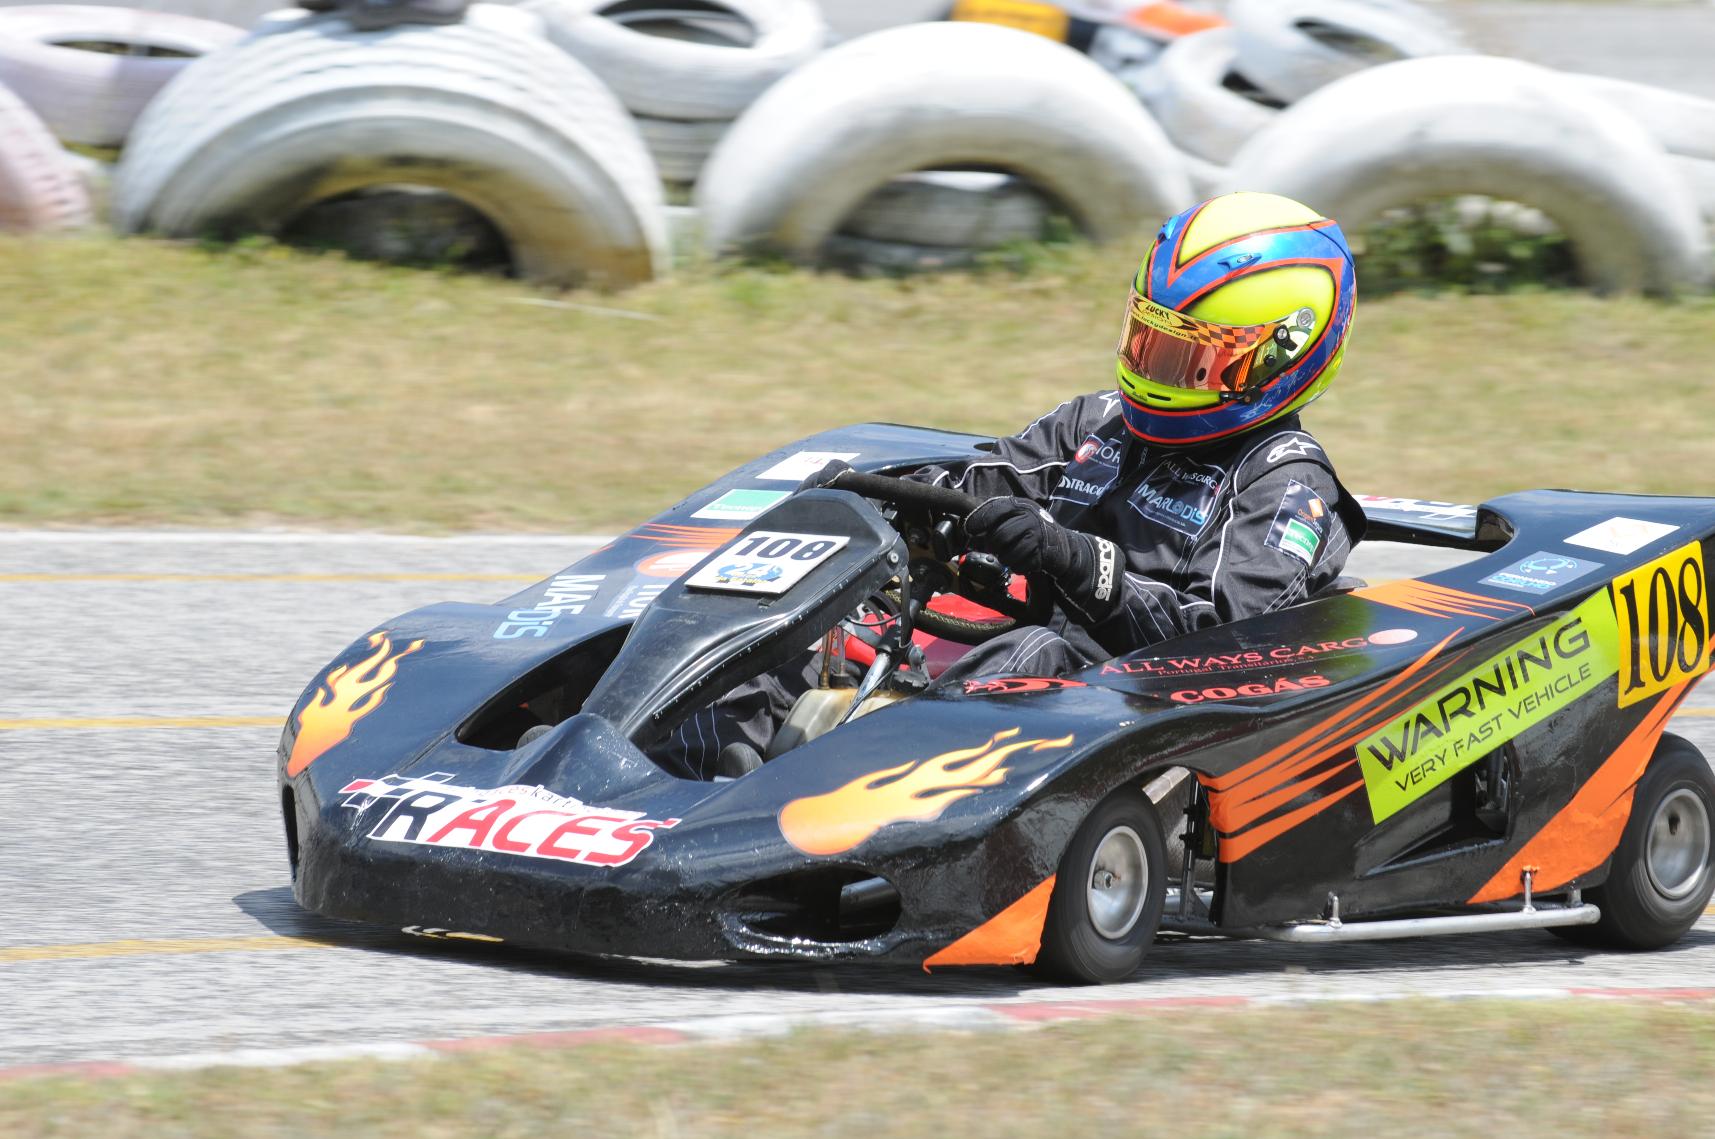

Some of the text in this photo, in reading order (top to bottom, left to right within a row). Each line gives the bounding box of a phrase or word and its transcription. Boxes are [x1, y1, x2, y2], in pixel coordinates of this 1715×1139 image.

[1146, 305, 1170, 320] LUCKY
[734, 536, 837, 561] 108
[1620, 556, 1706, 695] 108
[1101, 661, 1165, 676] ALL
[1167, 651, 1263, 671] WAYS
[1366, 616, 1592, 772] WARNING
[1395, 662, 1592, 792] VERY FAST VEHICLE
[370, 790, 656, 864] RACES
